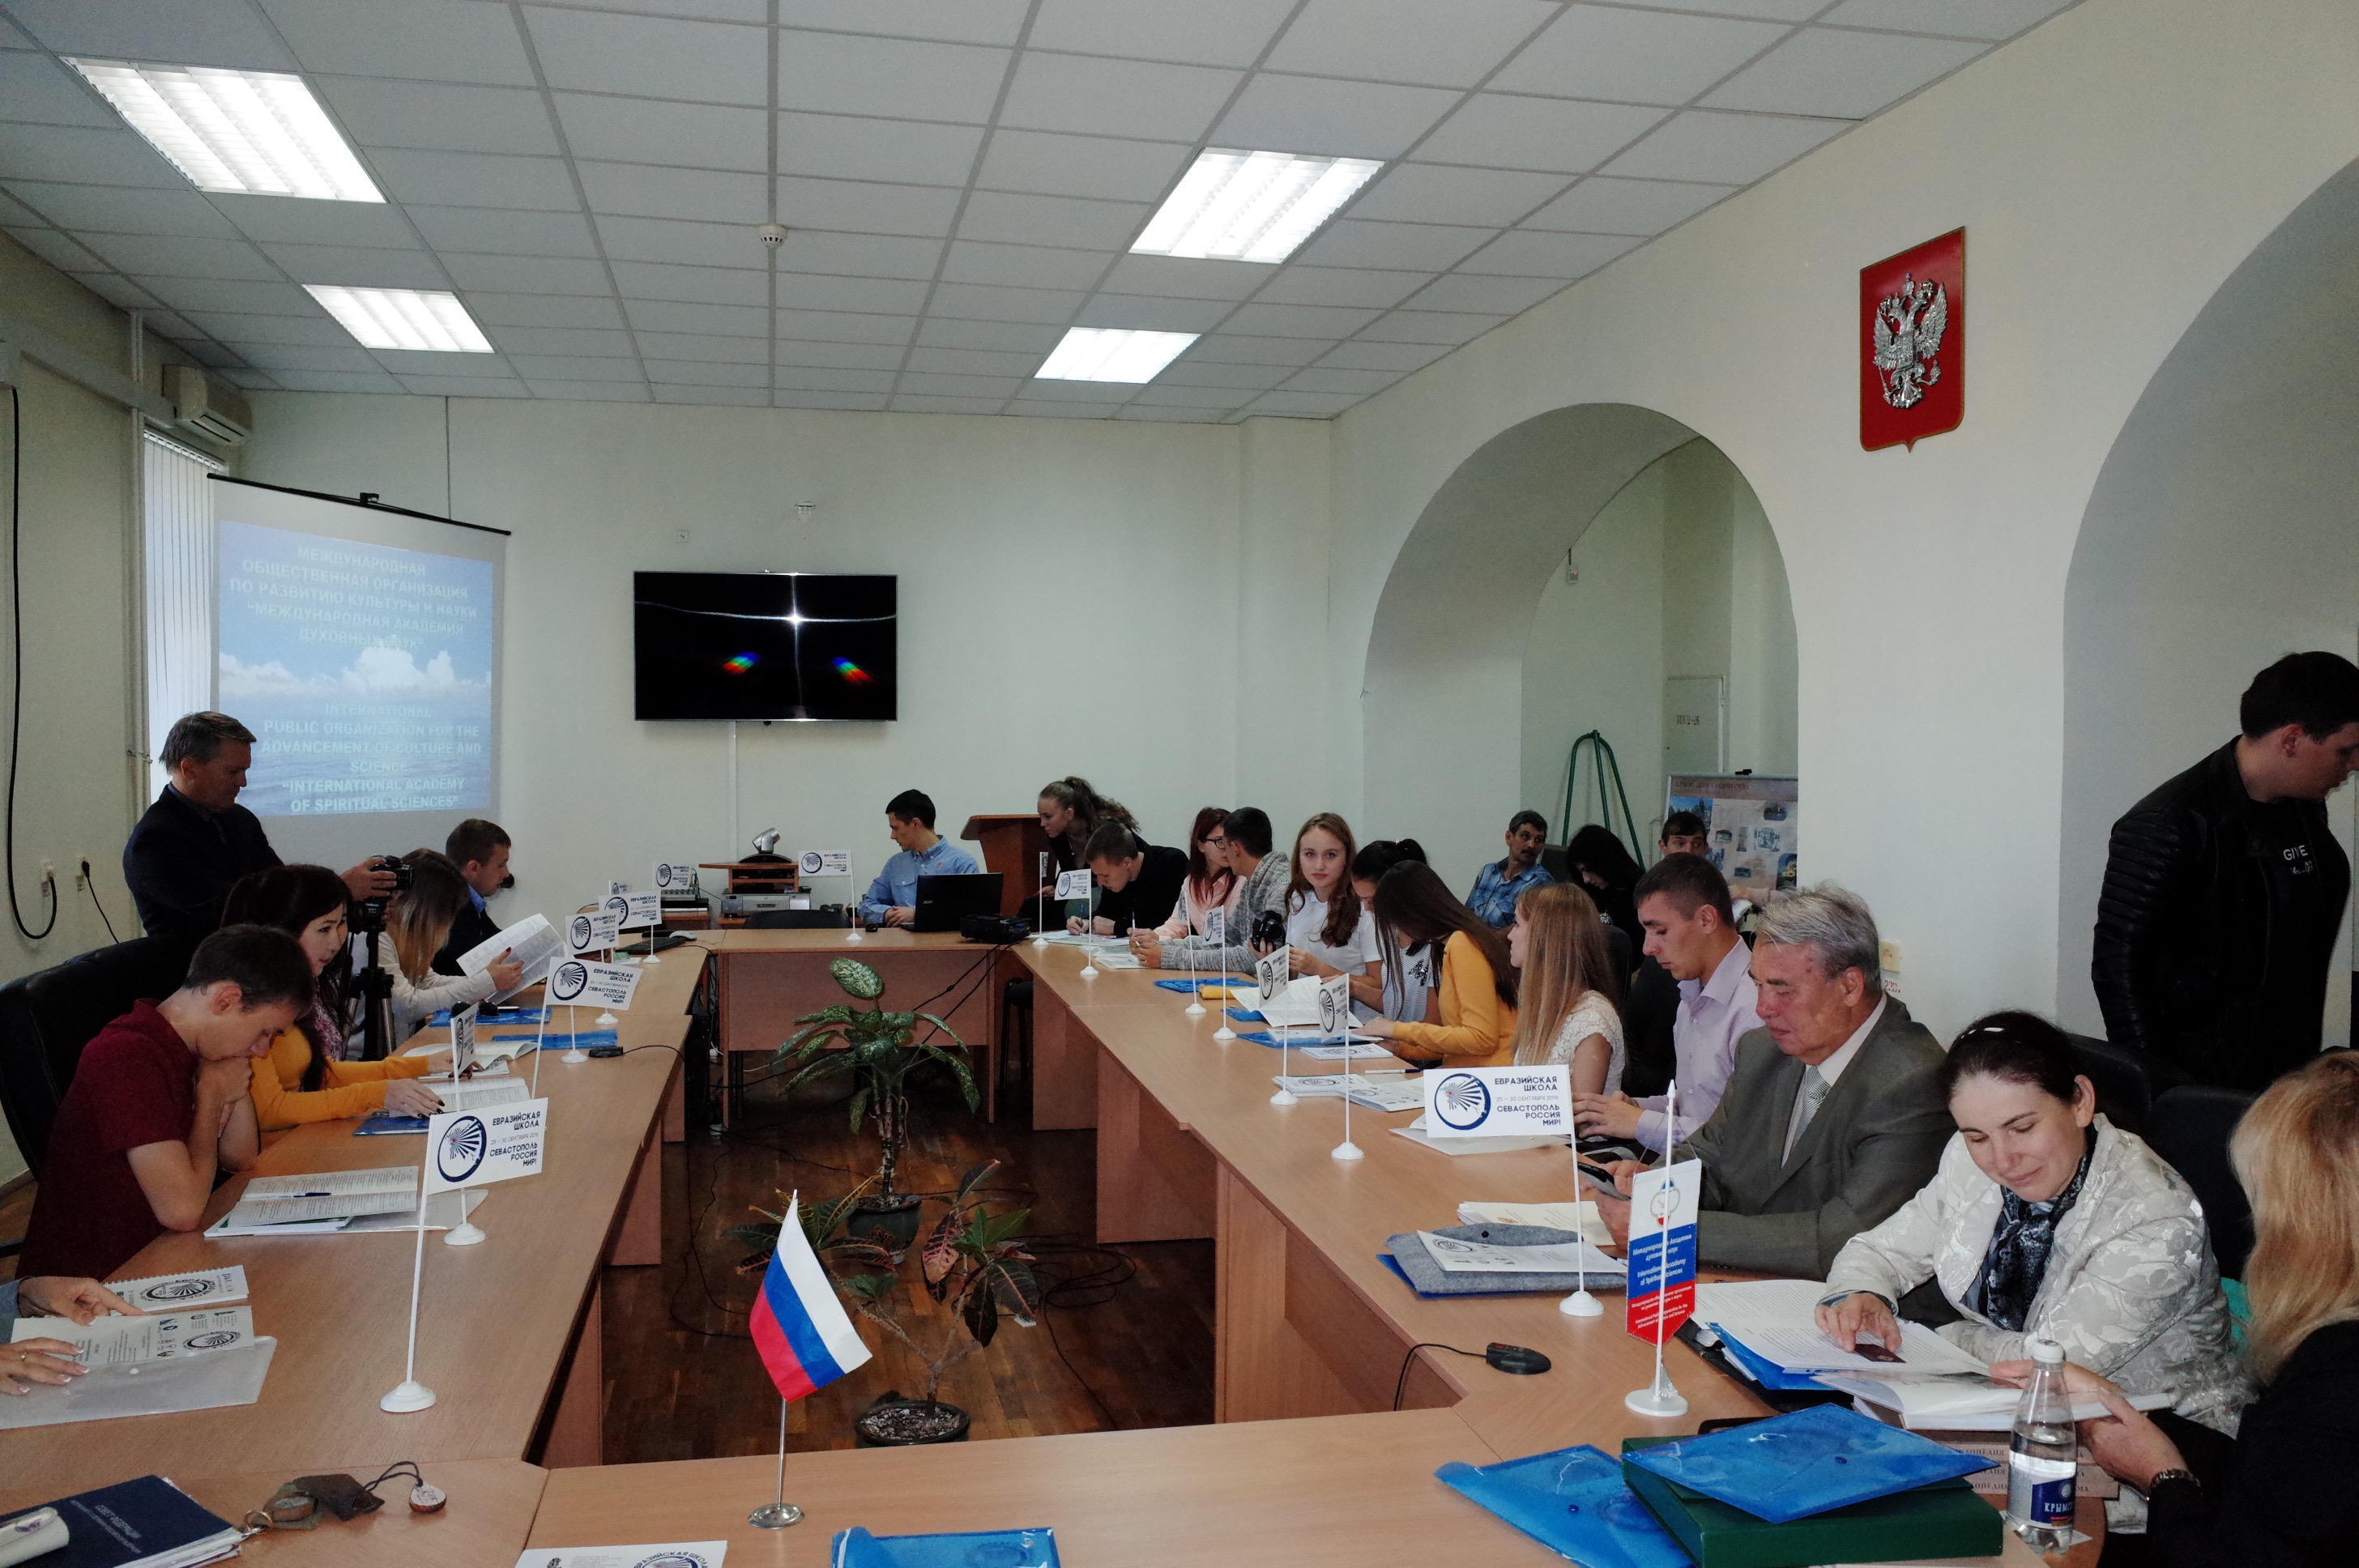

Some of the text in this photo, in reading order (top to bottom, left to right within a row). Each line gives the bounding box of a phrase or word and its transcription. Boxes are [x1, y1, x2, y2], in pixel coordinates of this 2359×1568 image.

[297, 545, 426, 577] МЕЖДУНАРОДНАЯ
[242, 559, 468, 601] ОБЩЕСТВЕННАЯ ОРГАНИЗАЦИЯ
[230, 577, 253, 593] ПО
[258, 582, 344, 605] РАЗВИТИЮ
[348, 593, 420, 613] КУЛЬТУРЫ
[436, 605, 477, 619] НАУКИ
[395, 618, 464, 635] АКАДЕМИЯ
[325, 702, 433, 718] INTERNATIONAL
[263, 719, 480, 738] PUBLIC ORGANIZATION FOR THE
[261, 739, 481, 754] ADVANCEMENT OF CULTURE AND
[350, 761, 408, 773] SCIENCE
[406, 778, 466, 790] ACADEMY
[290, 799, 311, 813] OF
[314, 797, 388, 812] SPIRITUAL
[1495, 1076, 1557, 1085] ЕВРАЗИЙСКАЯ
[1497, 1104, 1560, 1112] СЕВАСТОПОЛЬ
[493, 1110, 540, 1127] ЕВРАЗИЙСКАЯ
[514, 1120, 540, 1131] ШКОЛА
[489, 1142, 538, 1157] СЕВАСТОПОЛЬ
[510, 1149, 538, 1161] РОССИЯ
[523, 1158, 537, 1167] МИР!
